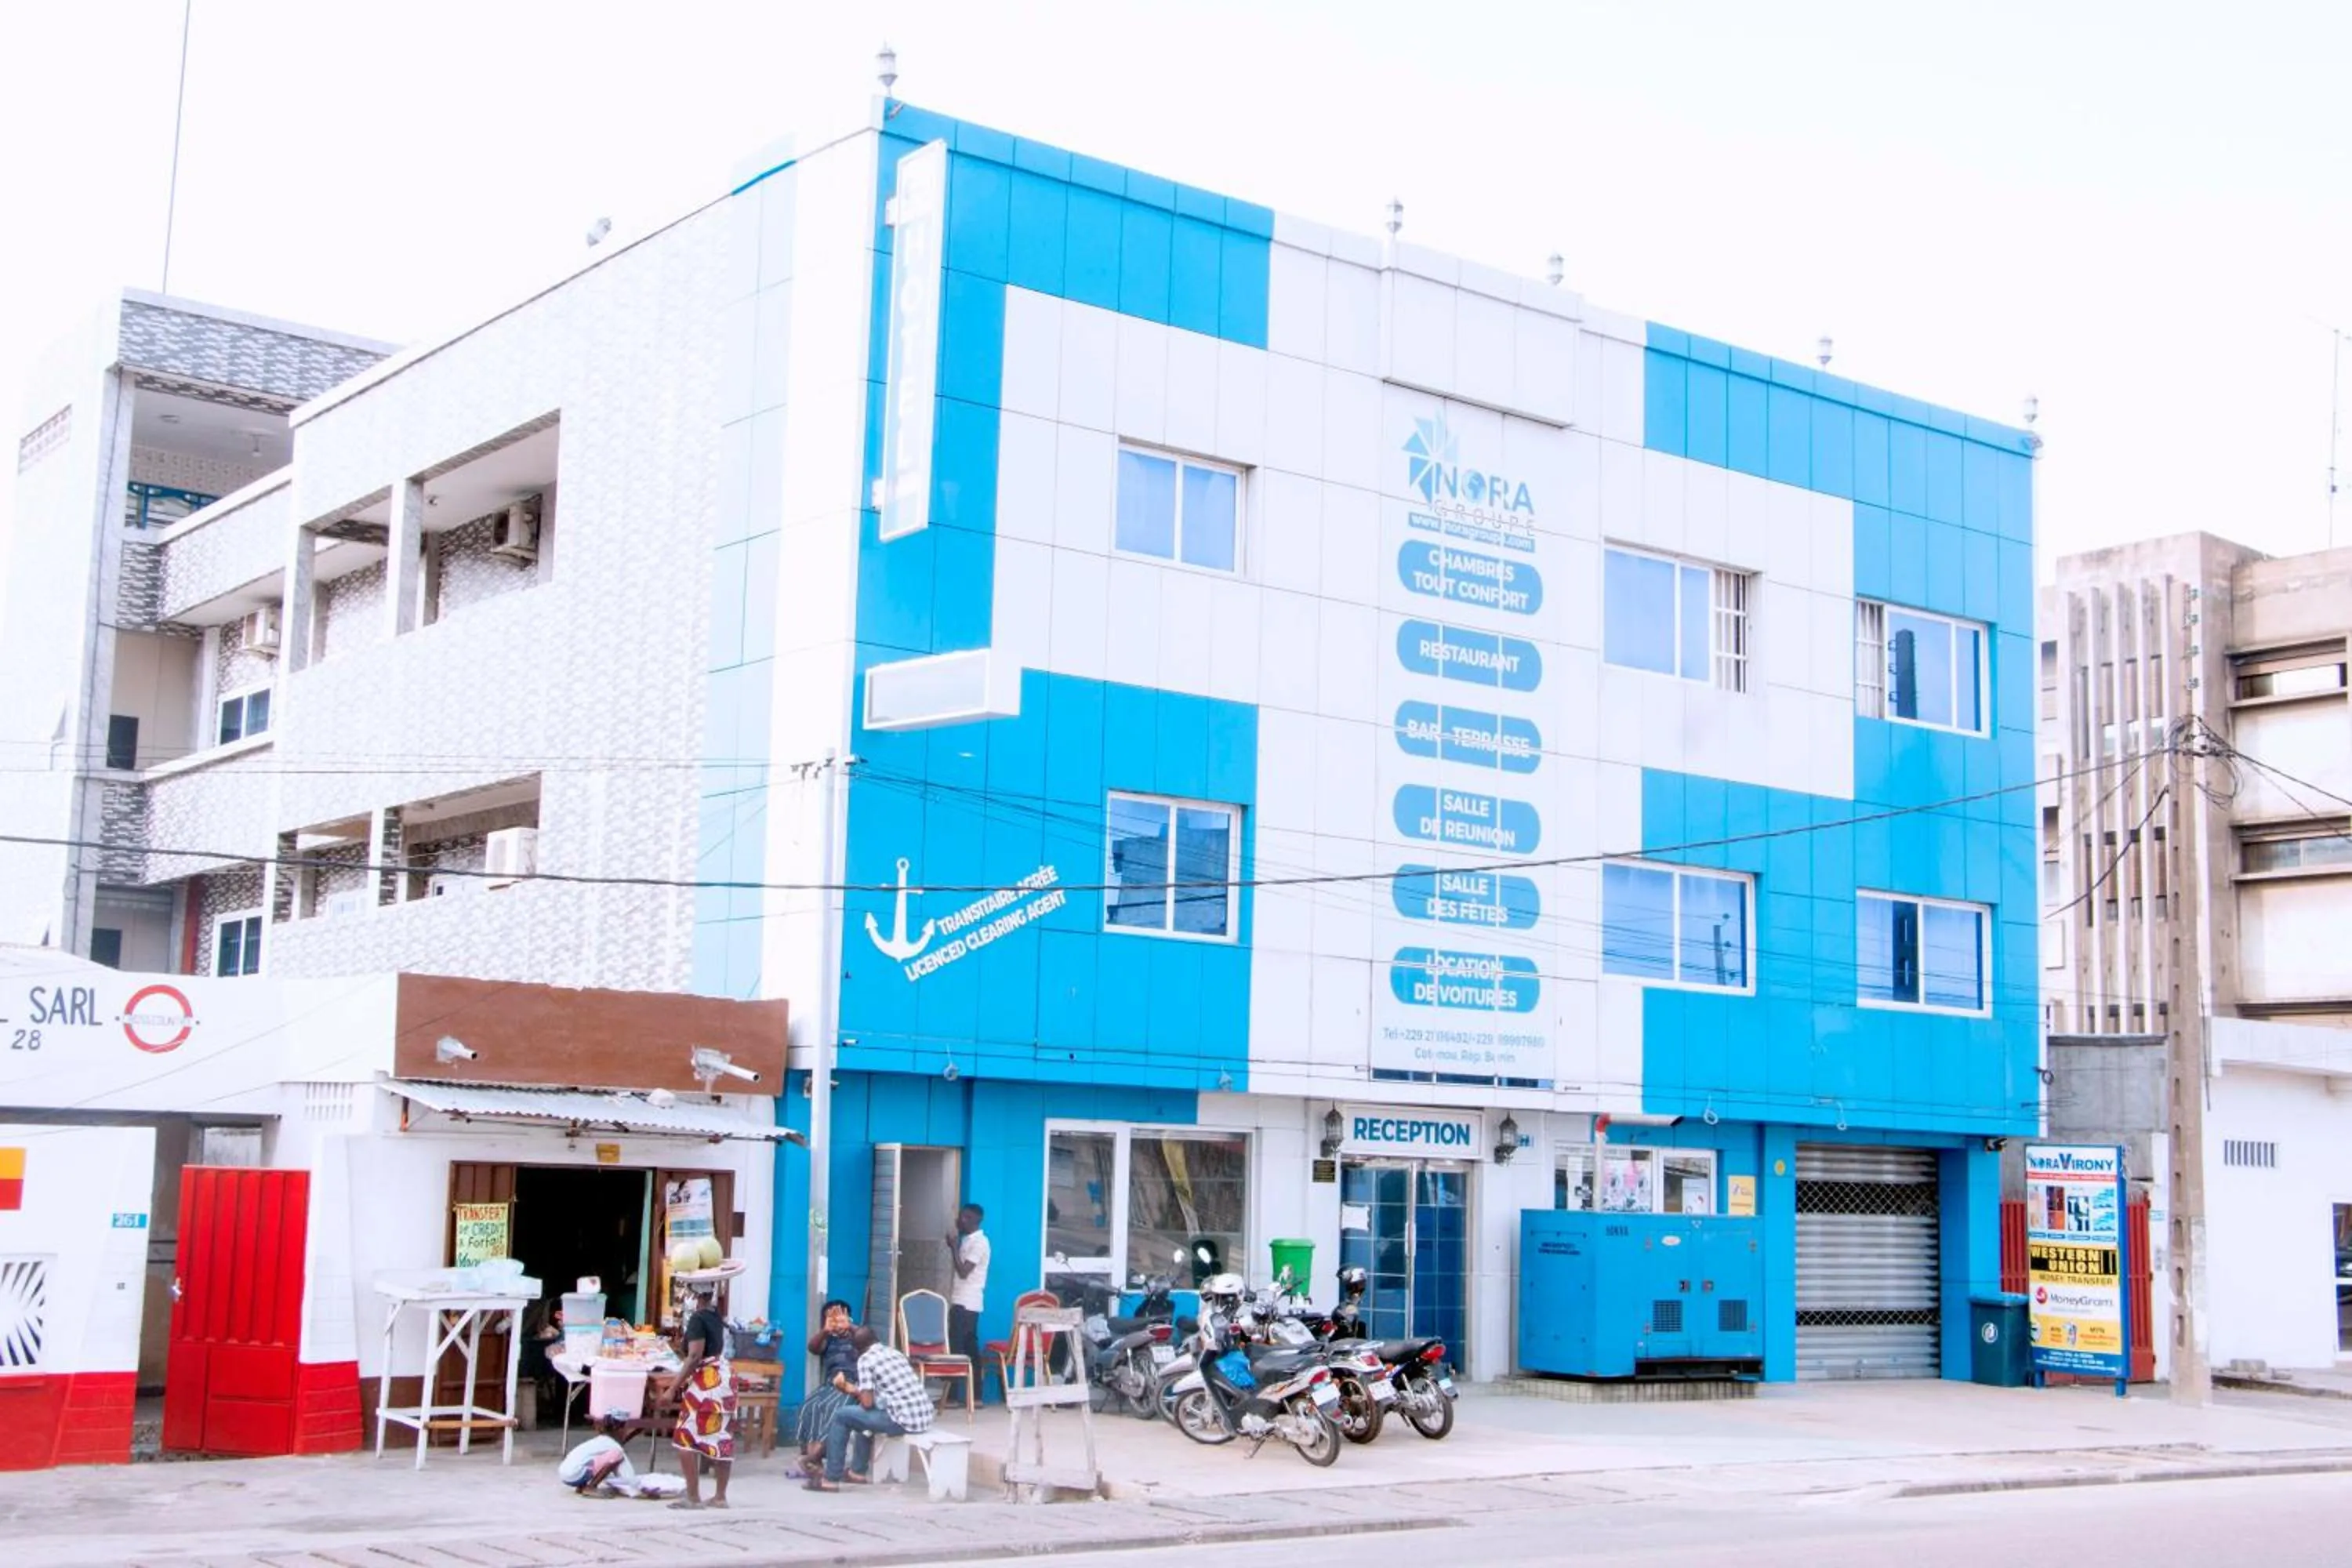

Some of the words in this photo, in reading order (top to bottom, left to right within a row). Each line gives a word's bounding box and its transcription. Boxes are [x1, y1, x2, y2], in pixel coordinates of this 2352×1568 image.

[1434, 462, 1535, 515] NORA
[1434, 499, 1535, 536] GROUPE
[1428, 550, 1515, 583] CHAMBRES
[1413, 570, 1456, 596] TOUT
[1458, 581, 1529, 609] CONFORT
[1420, 639, 1520, 673] RESTAURANT
[1406, 719, 1439, 741] BAR
[1452, 726, 1530, 758] TERRASSE
[1443, 793, 1490, 818] SALLE
[1420, 816, 1442, 836] DE
[1442, 874, 1489, 895] SALLE
[938, 887, 1018, 935] TRANSITAIRE
[1427, 898, 1457, 918] DES
[1459, 898, 1508, 923] FÊTES
[904, 939, 967, 982] LICENCED
[965, 909, 1027, 950] CLEARING
[1026, 890, 1066, 920] AGENT
[1425, 954, 1504, 981] LOCATION
[30, 985, 103, 1025] SARL
[1414, 982, 1436, 1001] DE
[1439, 985, 1517, 1007] VOITURES
[11, 1029, 42, 1051] 28
[1354, 1117, 1471, 1145] RECEPTION
[2031, 1245, 2100, 1261] WESTERN
[2049, 1260, 2100, 1274] UNION
[2067, 1276, 2113, 1285] TRANSFER
